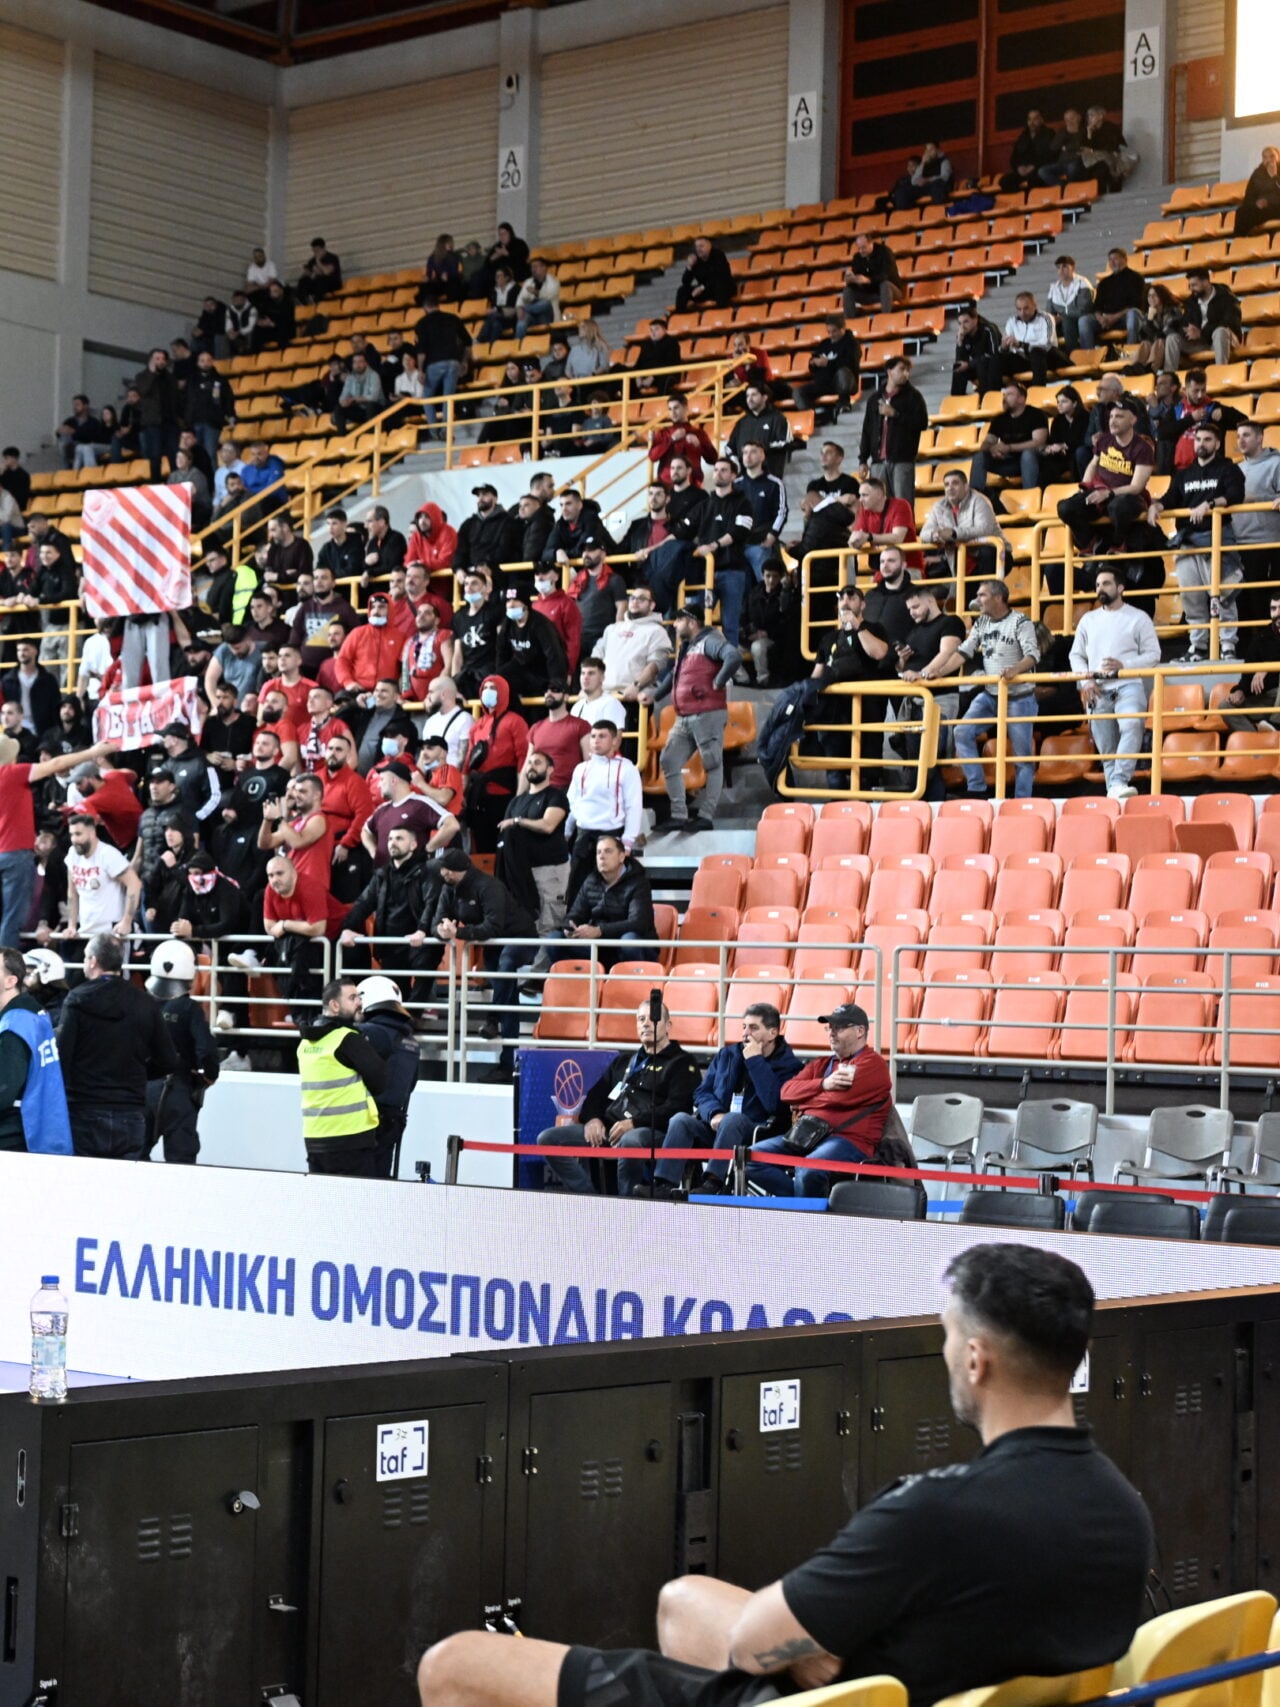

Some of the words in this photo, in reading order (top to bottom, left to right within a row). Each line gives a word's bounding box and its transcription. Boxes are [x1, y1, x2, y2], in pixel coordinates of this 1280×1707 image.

[1135, 32, 1151, 54] A
[1130, 54, 1156, 77] 19
[795, 96, 809, 117] A
[792, 117, 812, 138] 19
[505, 150, 518, 169] A
[500, 169, 520, 189] 20
[74, 1236, 296, 1317] ΕΛΛΗΝΙΚΗ
[311, 1260, 644, 1346] ΟΜΟΣΠΟΝΔΙΑ
[763, 1402, 784, 1427] taf
[380, 1446, 407, 1475] taf
